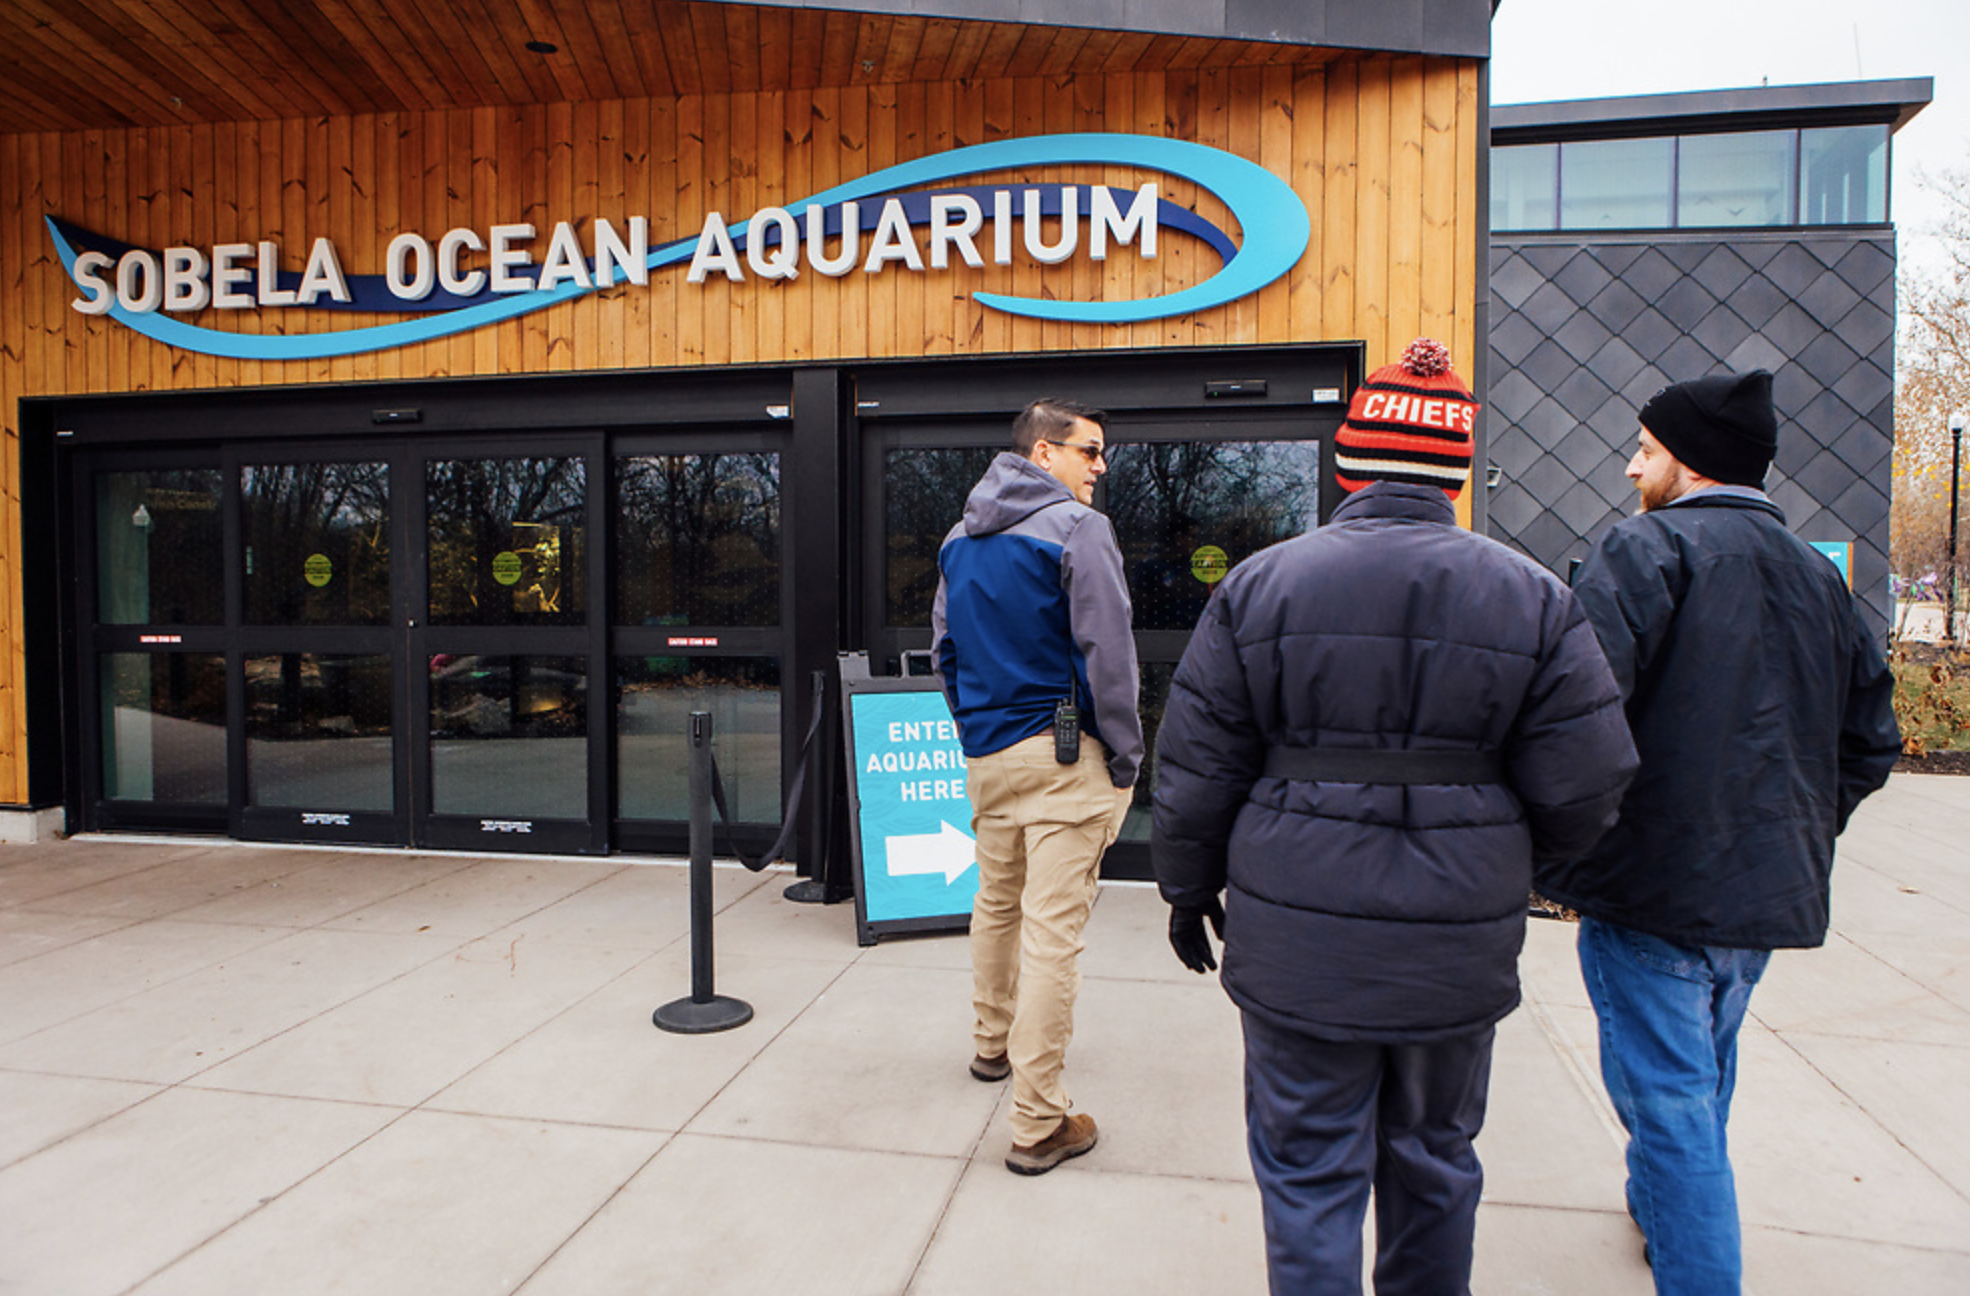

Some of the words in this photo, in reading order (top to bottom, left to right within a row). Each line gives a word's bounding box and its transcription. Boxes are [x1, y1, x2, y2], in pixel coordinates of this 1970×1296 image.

[71, 237, 352, 315] SOBELA
[386, 215, 649, 299] OCEAN
[686, 182, 1159, 283] AQUARIUM
[1362, 393, 1473, 431] CHIEFS
[901, 779, 965, 802] HERE
